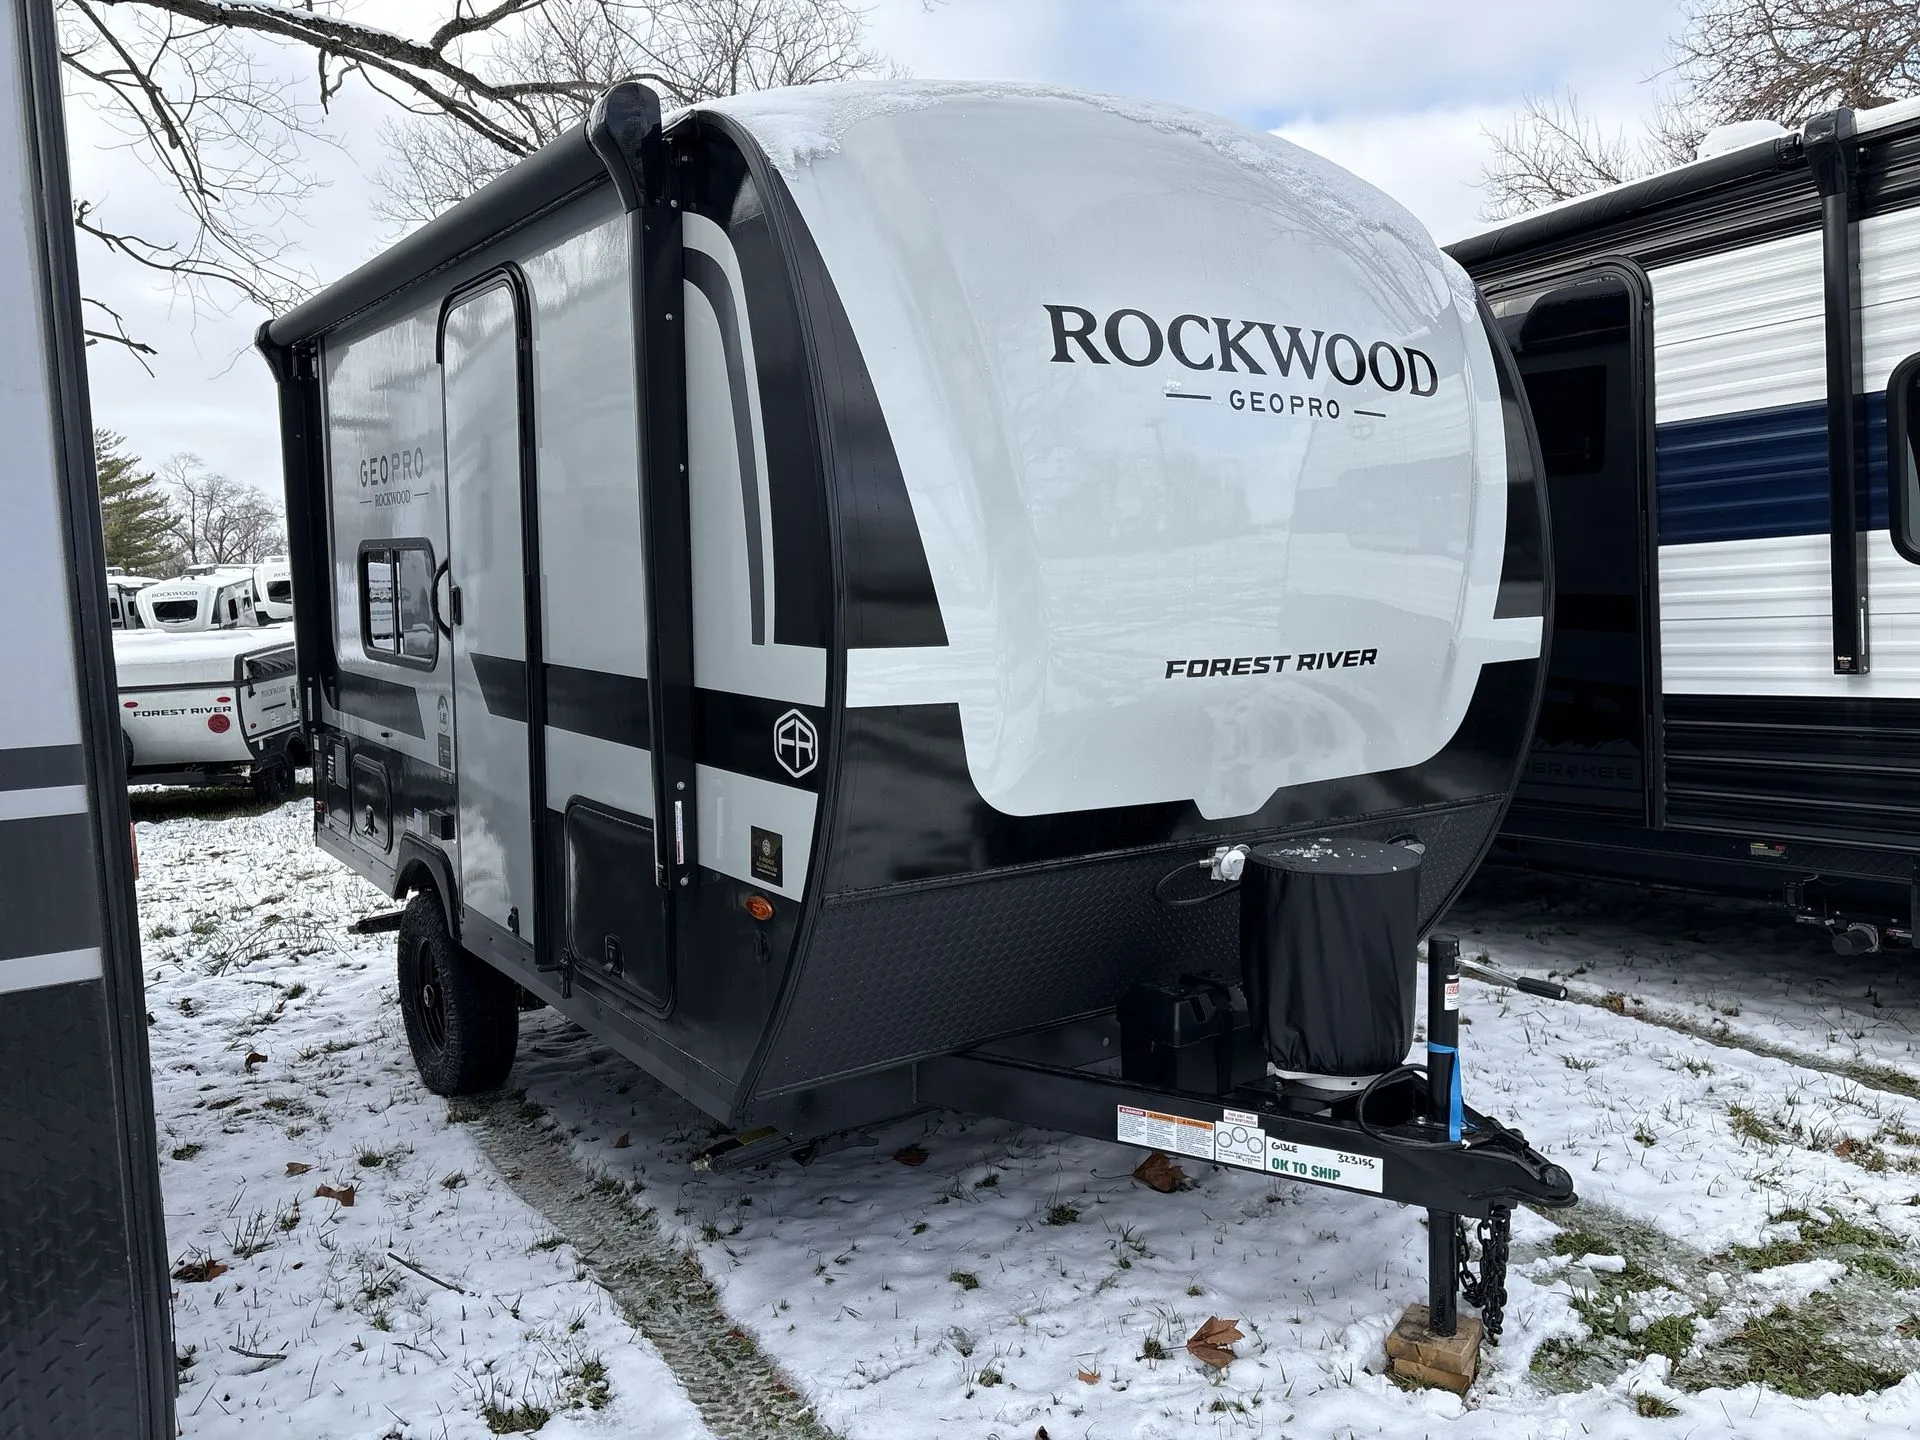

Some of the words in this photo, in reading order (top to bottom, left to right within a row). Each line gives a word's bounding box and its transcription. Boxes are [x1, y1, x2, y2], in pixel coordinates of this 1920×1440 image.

[1042, 304, 1439, 397] ROCKWOOD
[1229, 389, 1341, 419] GEOPRO
[360, 447, 423, 487] GEOPRO
[375, 489, 411, 507] ROCKWOOD
[151, 590, 198, 598] ROCKWOOD
[1164, 655, 1291, 679] FOREST
[1296, 648, 1378, 671] RIVER
[133, 708, 187, 717] FOREST
[191, 706, 232, 714] RIVER
[1526, 762, 1634, 780] EROKEE
[1272, 1158, 1289, 1172] OK
[1292, 1161, 1308, 1175] TO
[1311, 1165, 1341, 1180] SHIP
